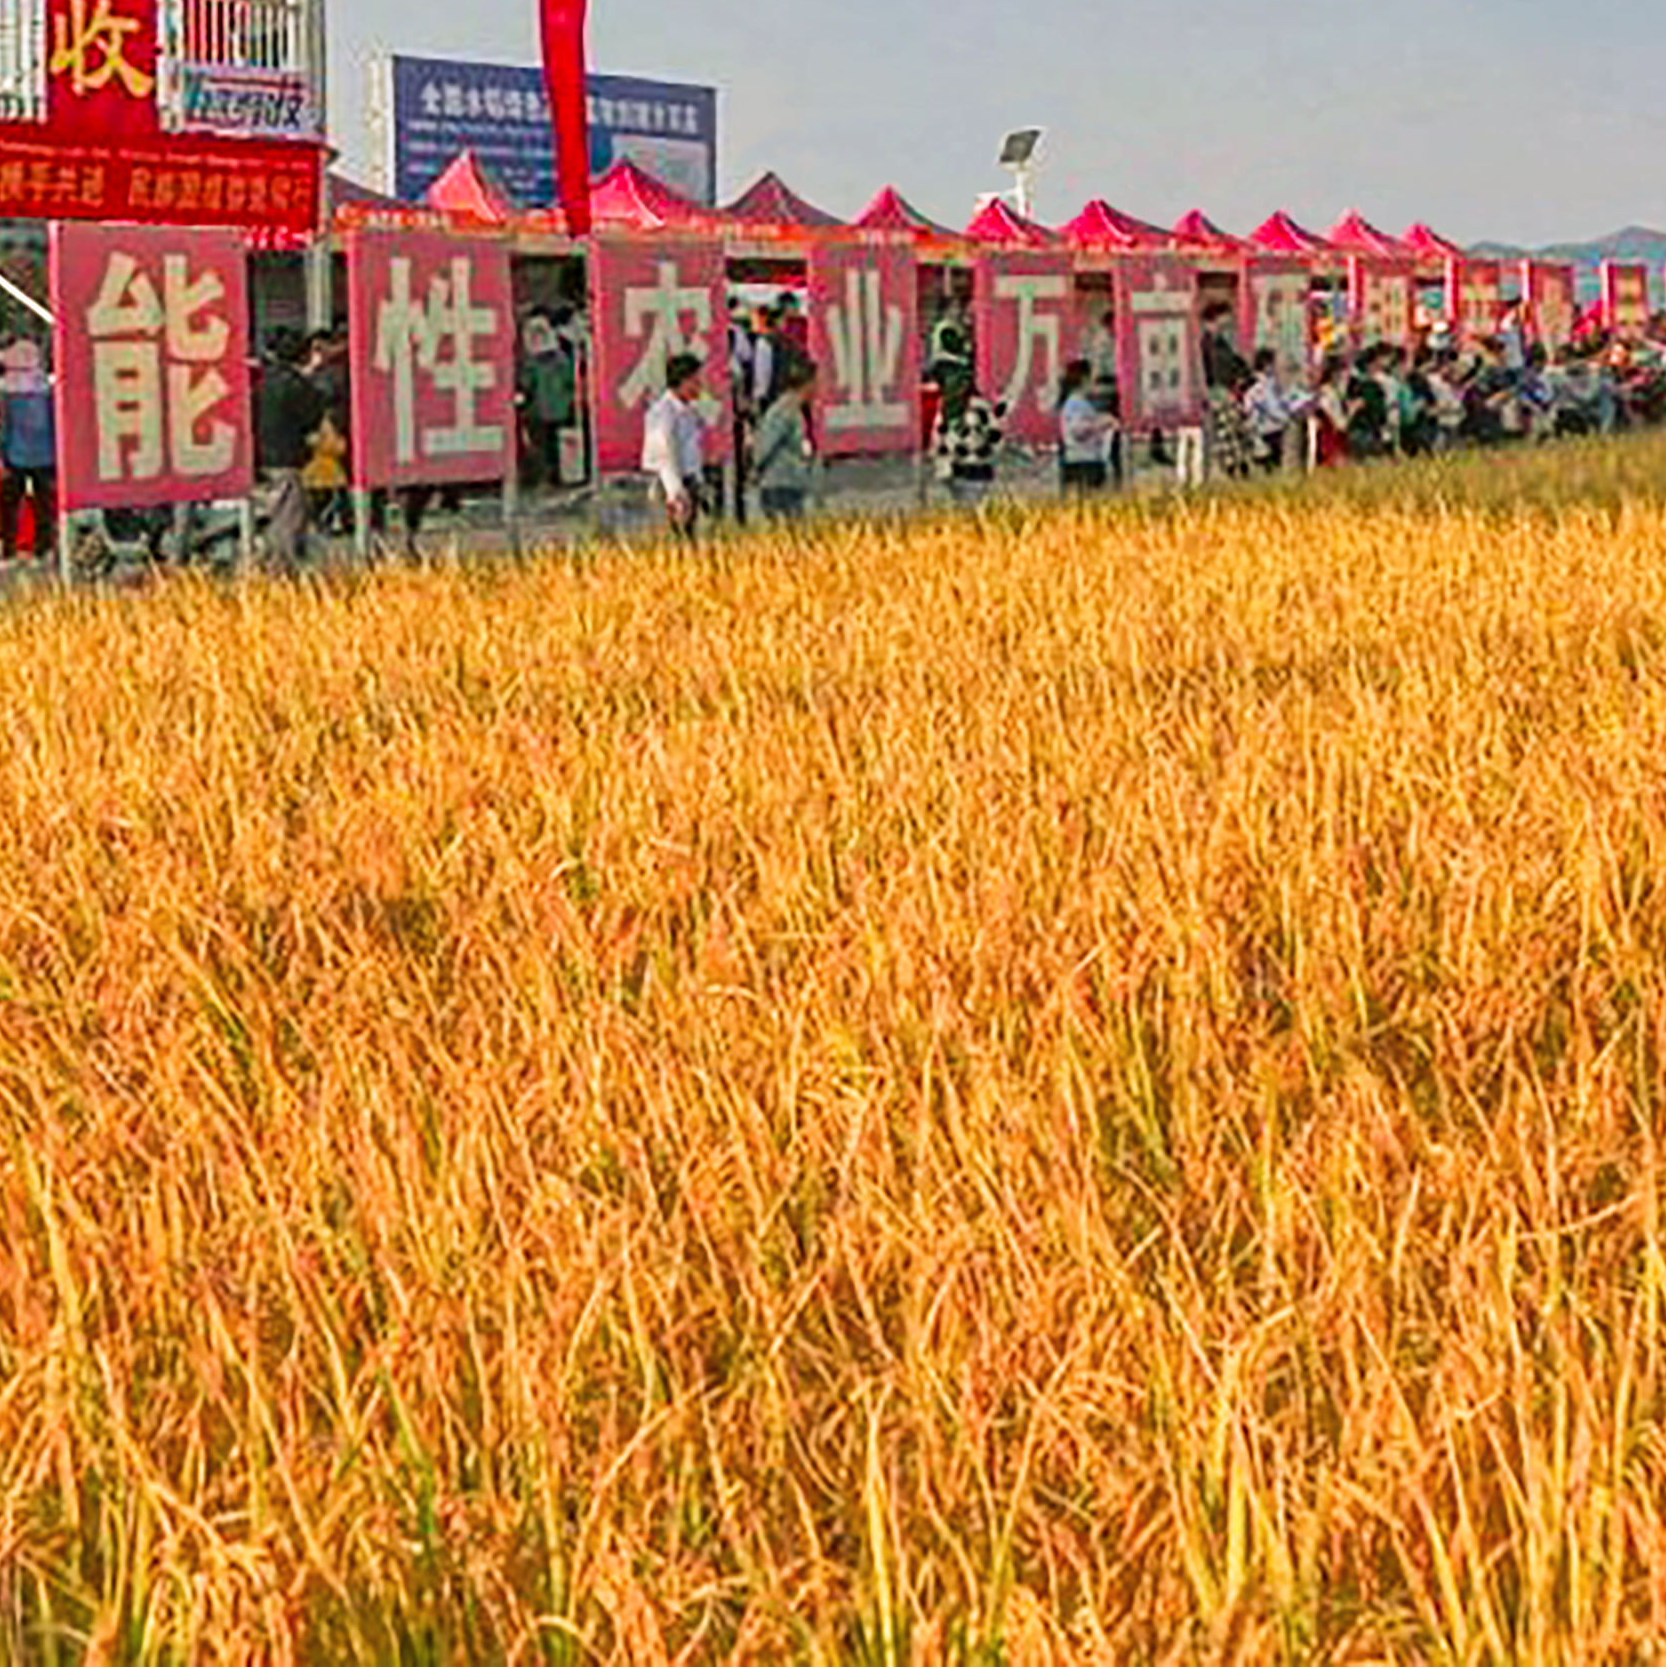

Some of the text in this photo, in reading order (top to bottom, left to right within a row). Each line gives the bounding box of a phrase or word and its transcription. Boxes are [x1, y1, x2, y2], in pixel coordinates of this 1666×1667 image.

[87, 252, 235, 481] 能
[374, 257, 503, 463] 性
[618, 261, 722, 426] 农
[825, 268, 911, 427] 业
[994, 274, 1068, 419] 万
[1132, 271, 1194, 416] 亩
